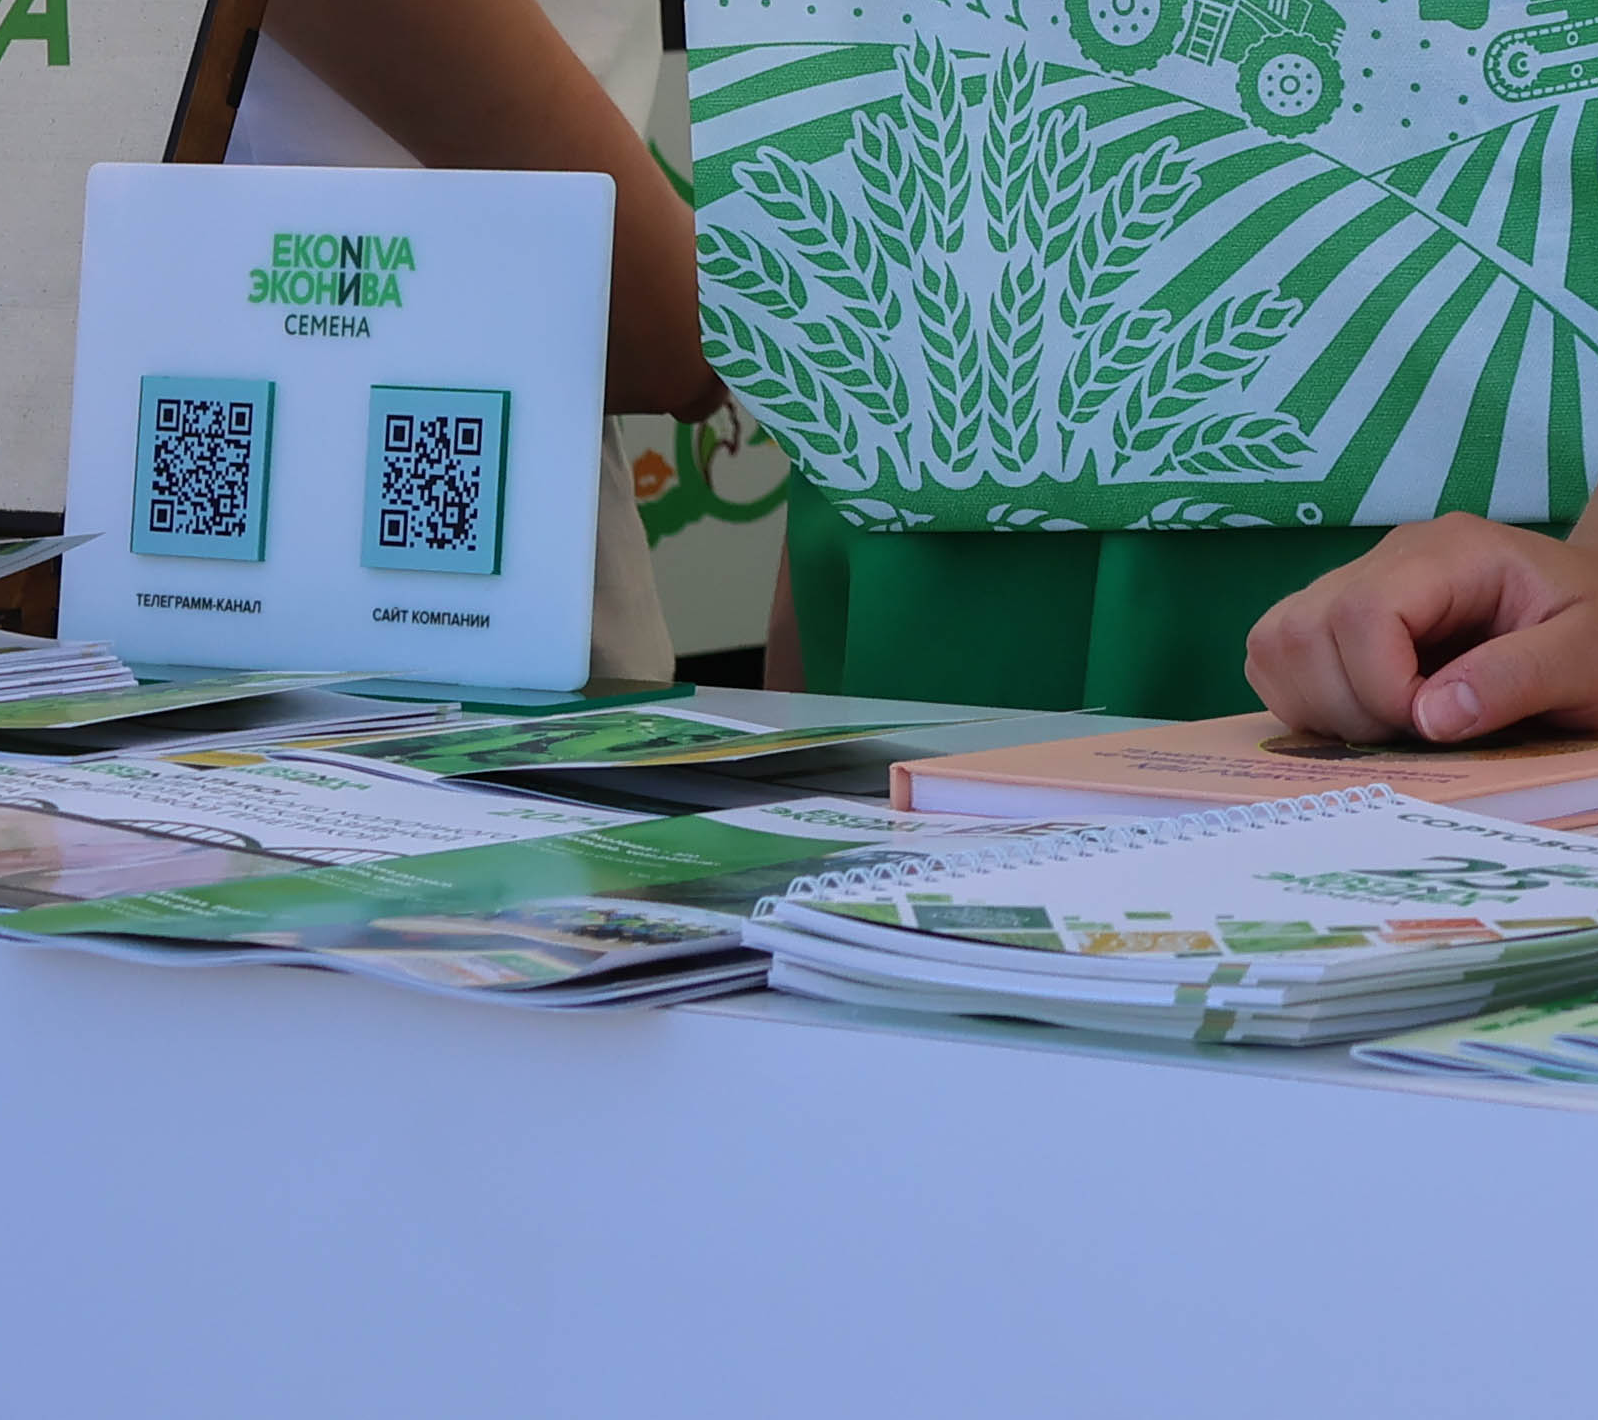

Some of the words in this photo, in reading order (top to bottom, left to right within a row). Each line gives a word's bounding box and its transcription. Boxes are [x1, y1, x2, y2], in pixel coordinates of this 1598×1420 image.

[271, 232, 416, 272] EKONIVA
[247, 268, 404, 309] ЭКОНИВА
[283, 312, 372, 339] СЕМЕНА
[135, 592, 263, 615] ТЕЛЕГРАММ-КАНАЛ
[370, 605, 410, 624] САЙТ
[411, 608, 492, 630] КОМПАНИИ
